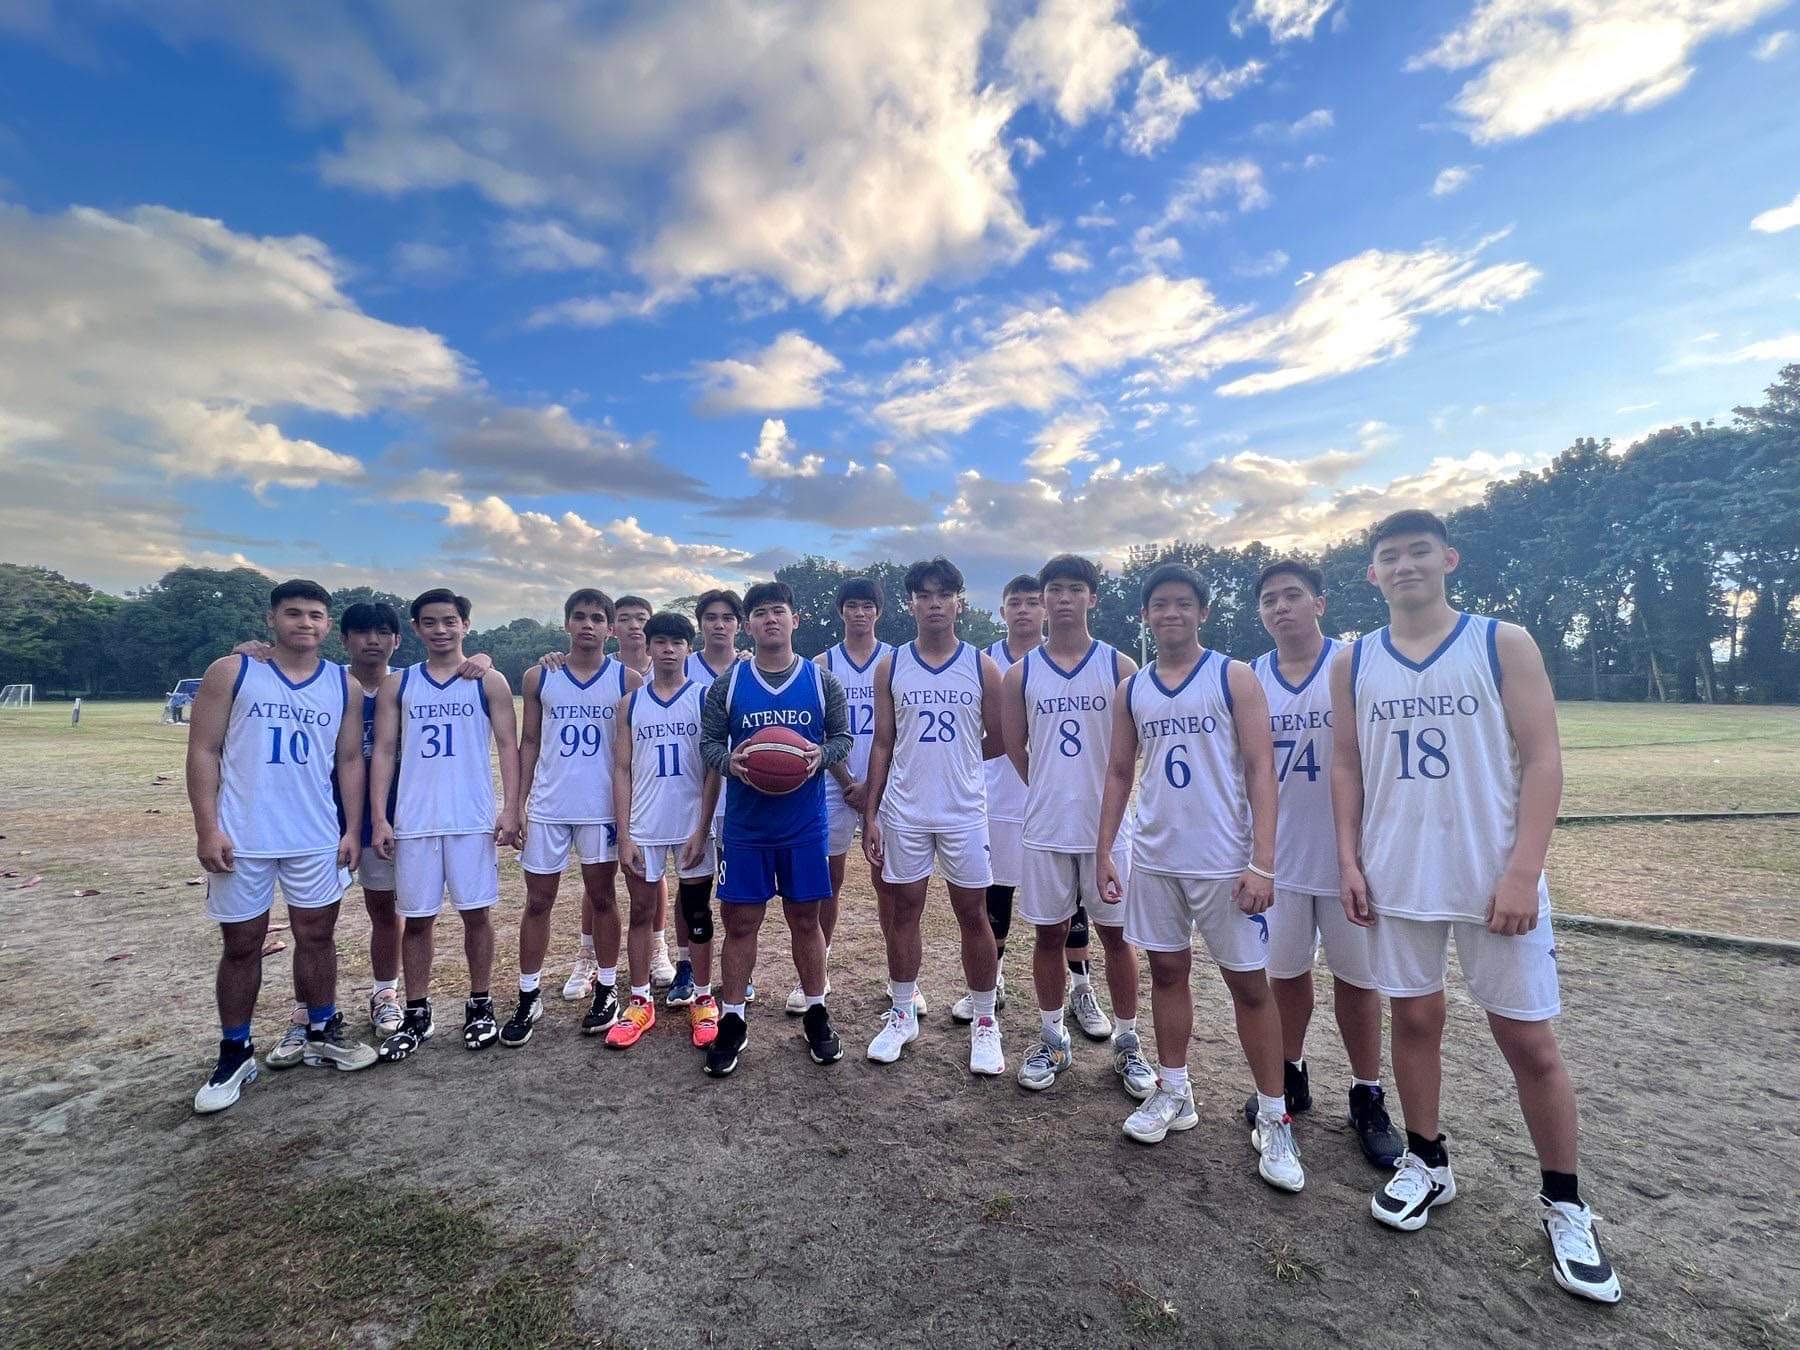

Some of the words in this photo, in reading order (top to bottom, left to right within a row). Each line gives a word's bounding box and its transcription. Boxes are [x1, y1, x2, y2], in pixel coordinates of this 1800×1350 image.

[549, 705, 614, 720] ATENEO
[901, 690, 973, 706] ATENEO
[1036, 696, 1106, 715] ATENEO
[1369, 694, 1479, 722] ATENEO
[246, 702, 331, 727] ATENEO
[742, 709, 812, 728] ATENEO
[847, 704, 874, 735] 12
[918, 710, 956, 742] 28
[266, 727, 309, 765] 10
[421, 723, 456, 759] 31
[560, 724, 601, 757] 99
[636, 722, 698, 741] ATENEO
[1059, 719, 1082, 757] 8
[654, 743, 684, 778] 11
[1165, 744, 1191, 789] 6
[1272, 738, 1321, 782] 74
[1391, 727, 1450, 779] 18
